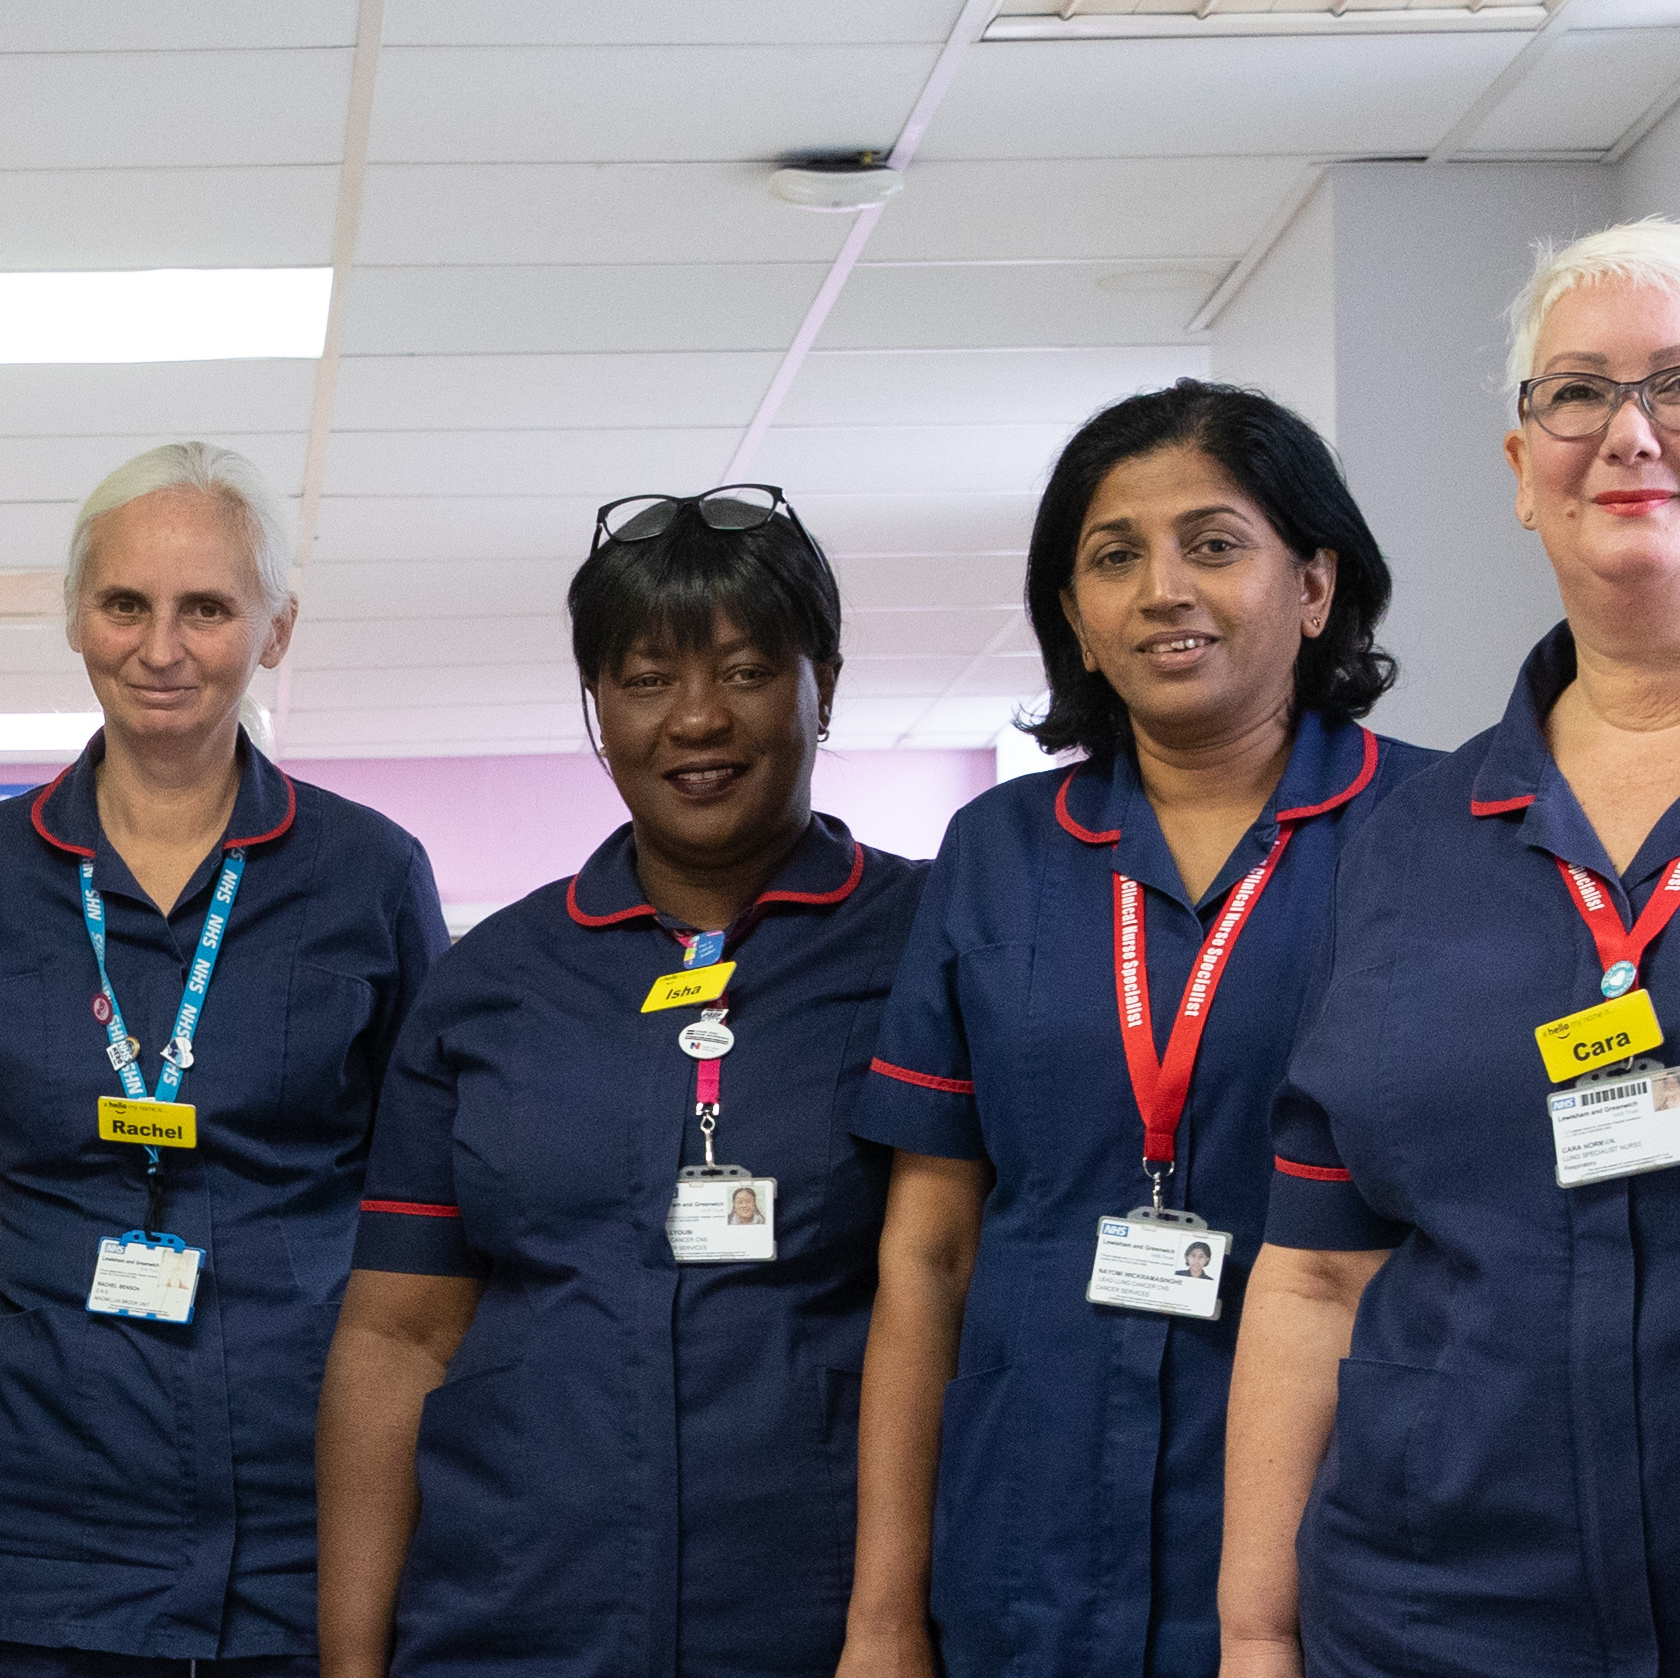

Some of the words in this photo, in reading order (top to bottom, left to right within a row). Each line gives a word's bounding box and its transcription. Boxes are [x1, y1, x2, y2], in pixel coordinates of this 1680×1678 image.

[216, 869, 238, 904] NHS
[1229, 867, 1265, 912] Clinical
[85, 889, 103, 921] NHS
[1121, 882, 1138, 926] Clinical
[202, 914, 224, 949] NHS
[1122, 925, 1138, 960] Nurse
[1211, 912, 1242, 947] Nurse
[189, 958, 211, 994] NHS
[1184, 947, 1224, 1017] Specialist
[666, 985, 701, 1001] Isha
[1121, 960, 1143, 1028] Specialist
[176, 1003, 198, 1038] NHS
[1548, 1023, 1569, 1036] hello
[1583, 1012, 1603, 1023] name
[1573, 1031, 1632, 1062] Cara
[122, 1062, 144, 1094] NHS
[109, 1100, 127, 1109] hello
[1552, 1099, 1574, 1110] NHS
[1558, 1111, 1590, 1122] Lewisham
[1604, 1101, 1638, 1113] Greenwich
[112, 1120, 182, 1139] Rachel
[1562, 1144, 1582, 1153] CARA
[1103, 1226, 1127, 1236] NHS
[1103, 1240, 1131, 1248] Lewisham
